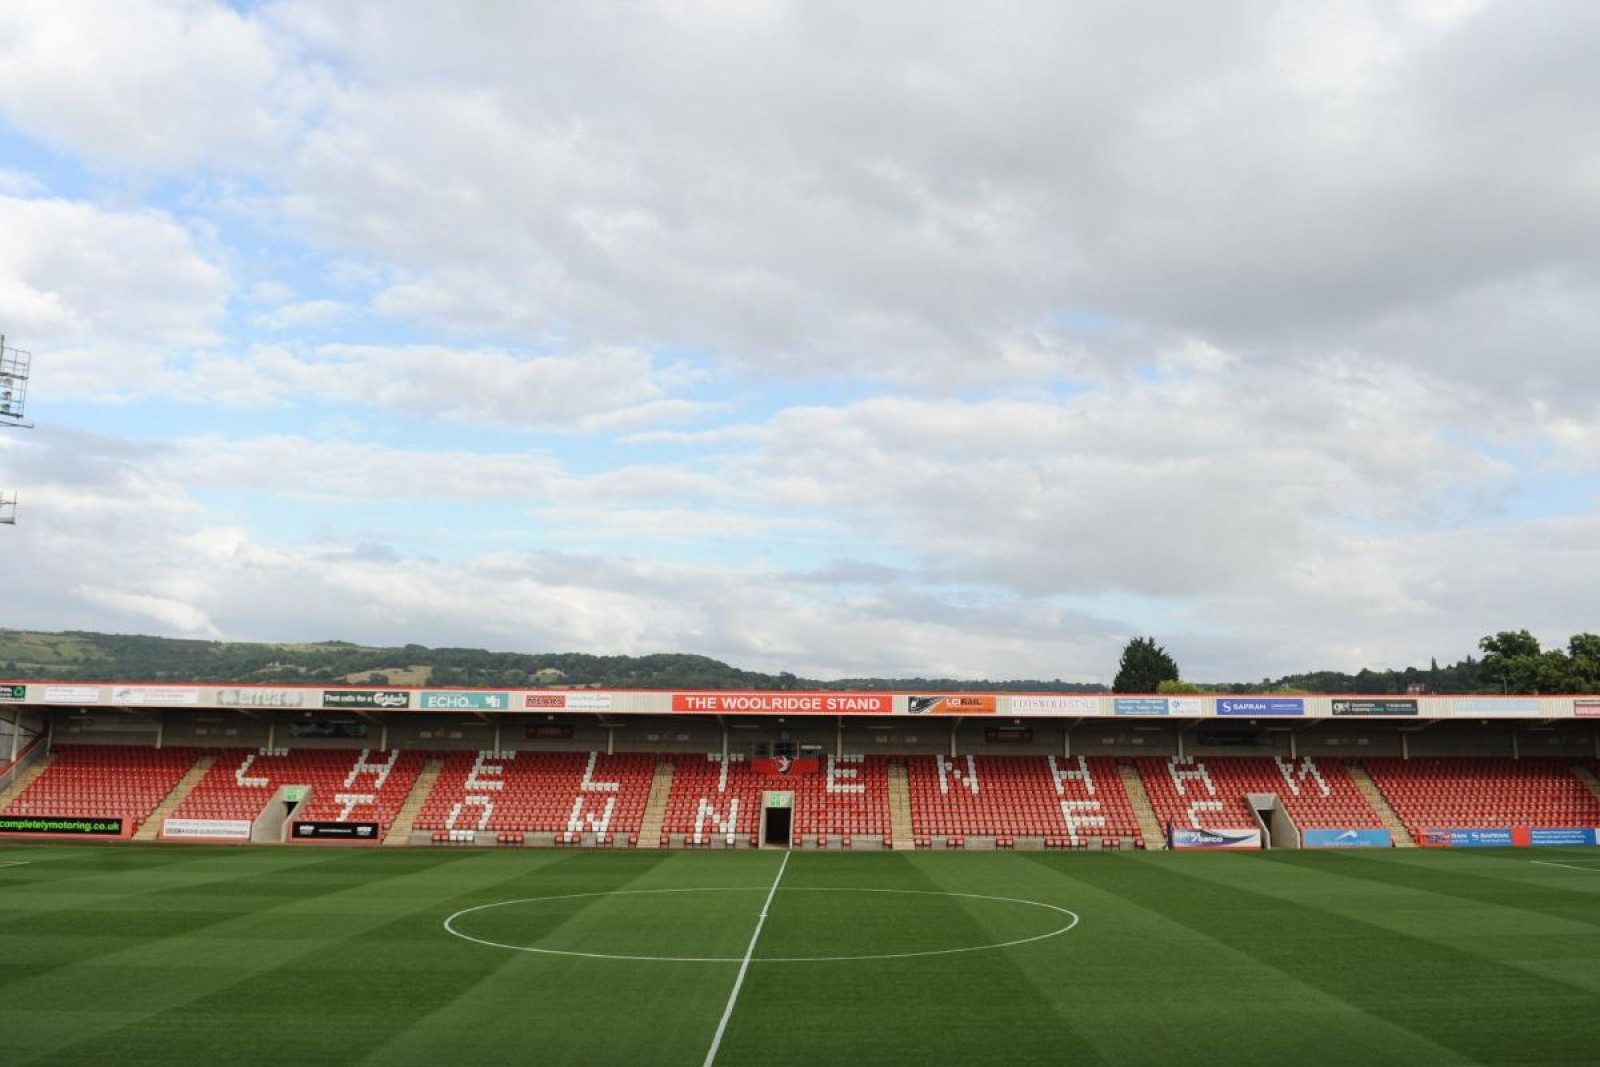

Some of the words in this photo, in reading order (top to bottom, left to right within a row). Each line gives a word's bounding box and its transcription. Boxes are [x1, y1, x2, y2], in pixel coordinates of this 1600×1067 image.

[427, 695, 469, 707] ECHO
[685, 697, 717, 709] THE
[721, 697, 821, 709] WOOLRIDGE
[826, 697, 880, 710] STAND
[0, 819, 120, 832] completelymotoring.co.uk
